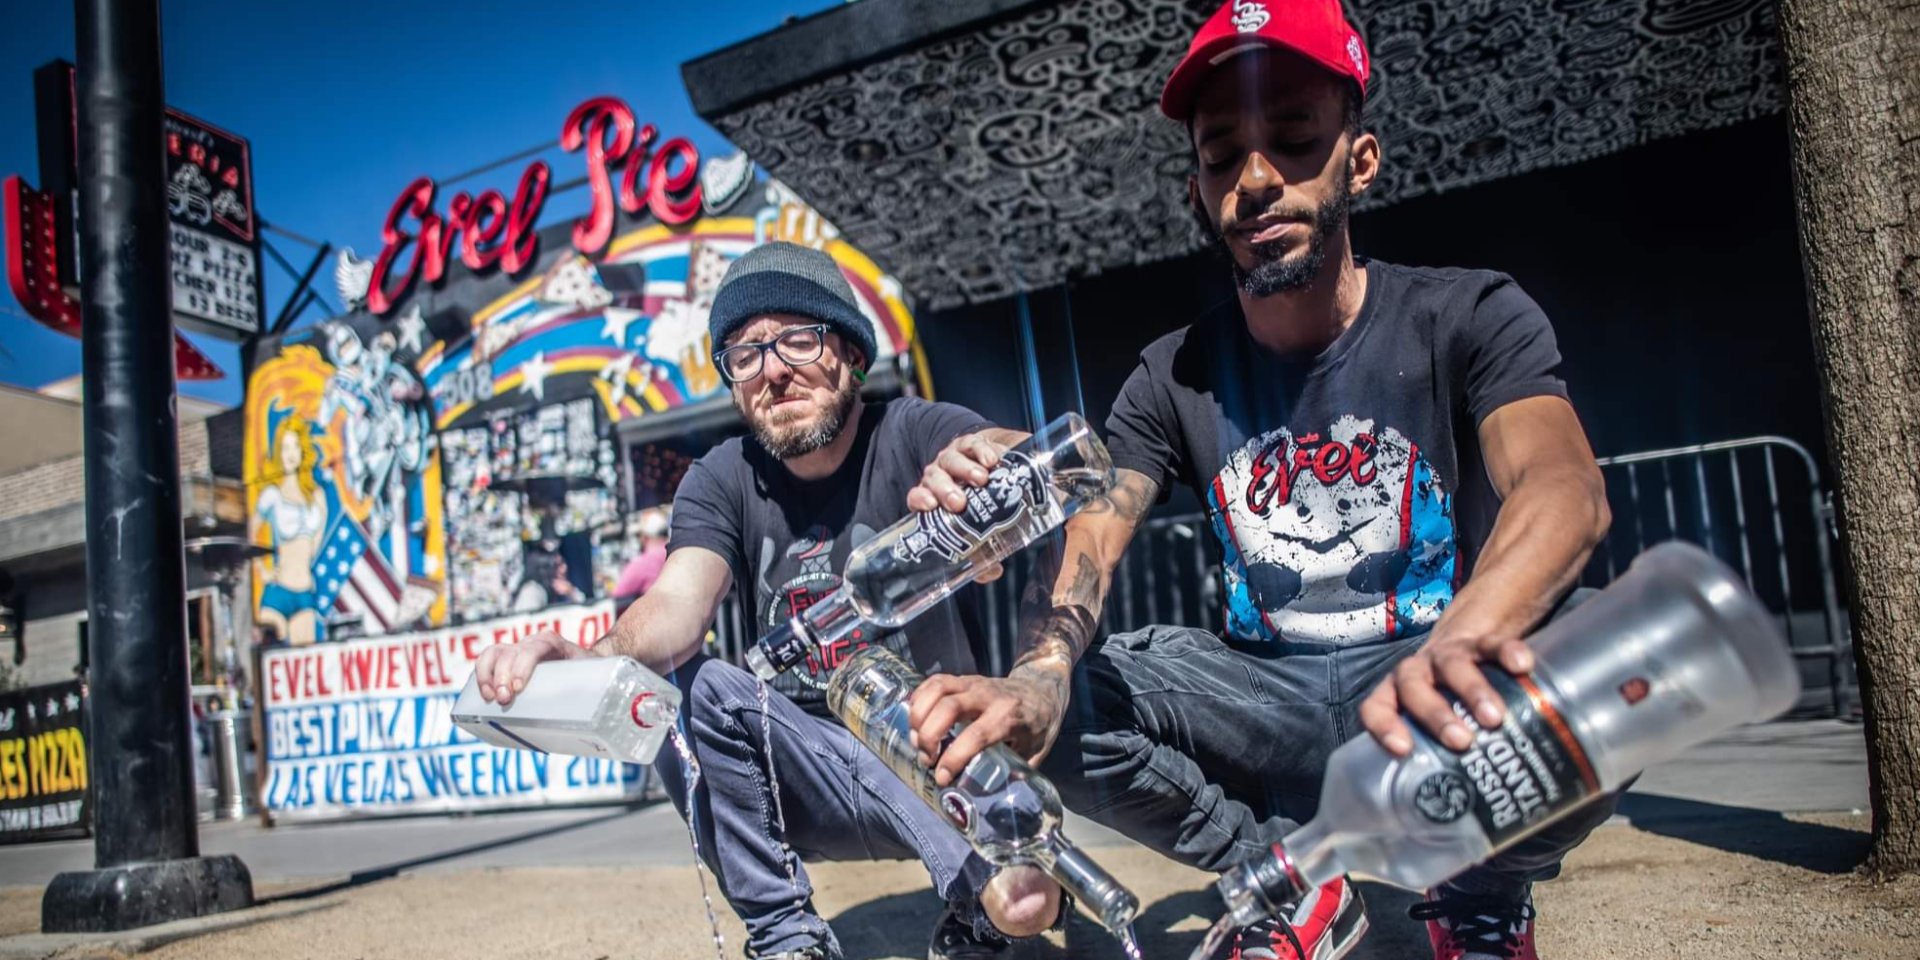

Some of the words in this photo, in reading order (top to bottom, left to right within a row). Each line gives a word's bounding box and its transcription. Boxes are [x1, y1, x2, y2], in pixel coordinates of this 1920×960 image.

[367, 160, 550, 315] Evel
[561, 96, 702, 254] Pie
[174, 231, 209, 254] OUR
[269, 656, 331, 702] EVEL
[270, 704, 335, 760] BEST
[338, 698, 418, 754] PIZZA
[28, 727, 88, 796] PIZZA
[268, 765, 317, 809] LAS
[325, 758, 415, 803] VEGAS
[416, 750, 549, 798] WEEKLY
[1460, 740, 1521, 829] RUSSI
